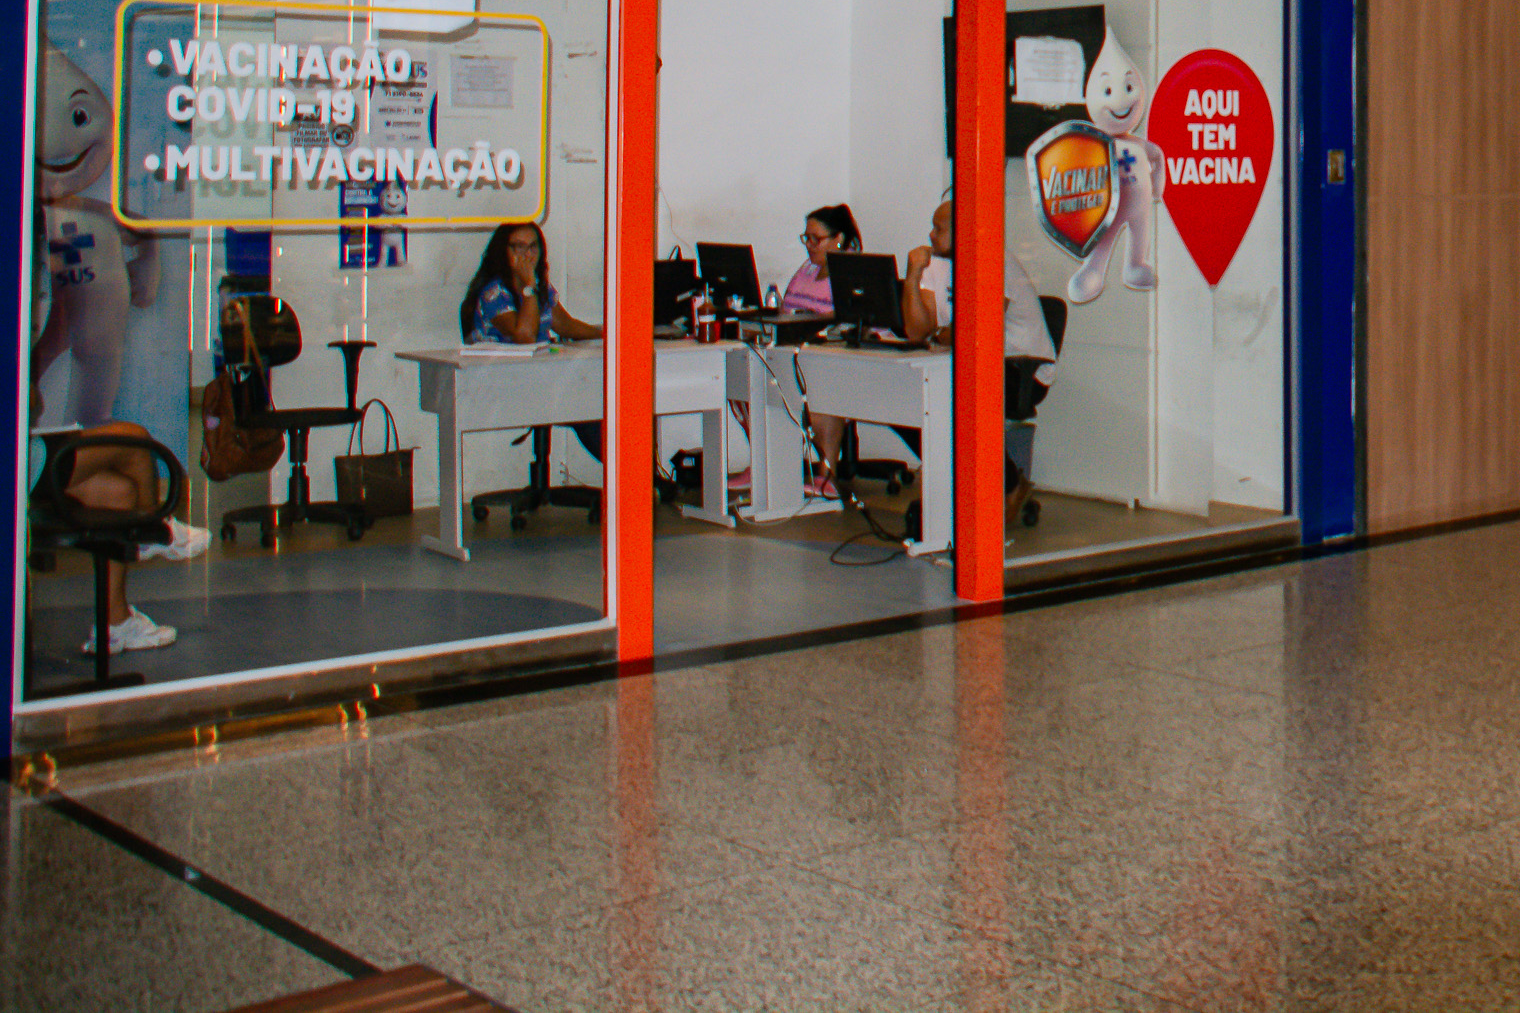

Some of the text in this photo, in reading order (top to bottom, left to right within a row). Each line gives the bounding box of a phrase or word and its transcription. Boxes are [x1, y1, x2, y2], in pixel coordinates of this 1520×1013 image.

[169, 39, 413, 88] VACINAÇÃO
[167, 86, 356, 124] COVID-19
[1184, 89, 1240, 119] AQUI
[1187, 123, 1236, 150] TEM
[164, 141, 522, 186] MULTIVACINAÇÃO
[1167, 157, 1256, 185] VACINA
[56, 267, 95, 286] SUS
